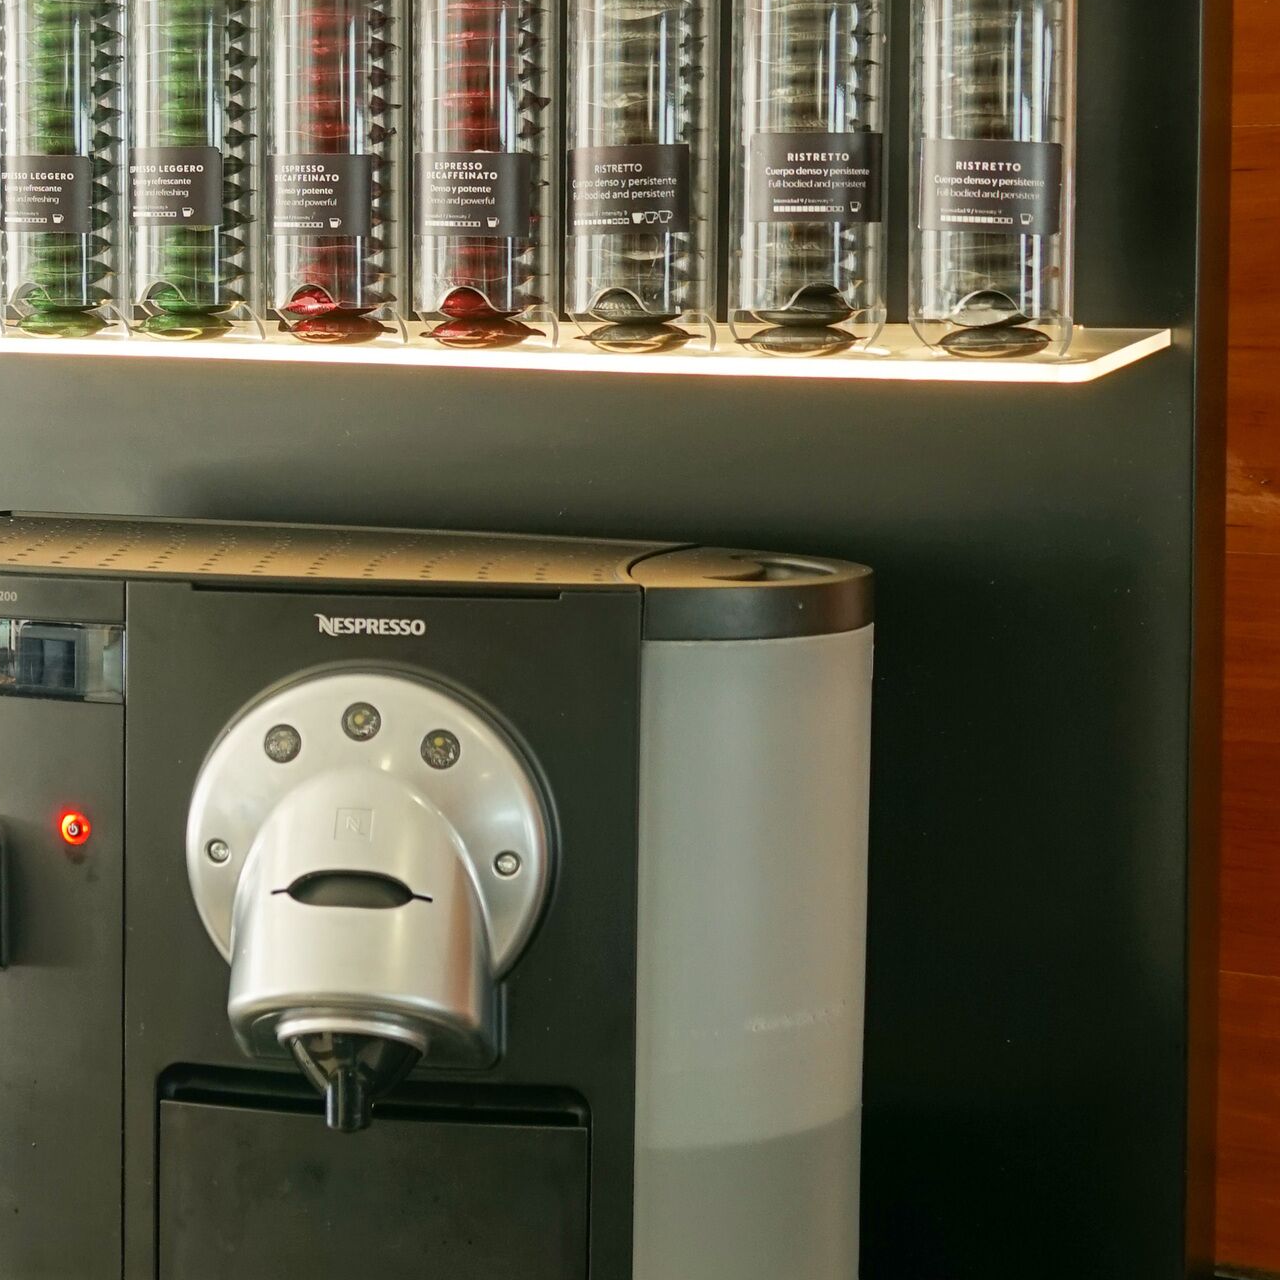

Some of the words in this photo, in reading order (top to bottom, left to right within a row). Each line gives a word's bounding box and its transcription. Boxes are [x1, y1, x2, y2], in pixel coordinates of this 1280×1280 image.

[787, 153, 849, 161] RISTRETTO
[159, 165, 204, 173] LEGGERO
[281, 165, 325, 173] ESPRESSO
[434, 162, 483, 170] ESPRESSO
[594, 163, 643, 174] RISTRETTO
[956, 161, 1021, 171] RISTRETTO
[426, 172, 498, 180] DECAFFEINATO
[765, 167, 794, 177] Cuerpo
[796, 167, 822, 175] denso
[830, 168, 870, 176] persistente
[151, 178, 192, 186] refrescante
[595, 178, 619, 188] denso
[621, 180, 627, 188] y
[628, 177, 677, 188] persistente
[814, 180, 830, 188] and
[832, 181, 866, 189] persistent
[934, 175, 962, 185] Cuerpo
[963, 176, 991, 185] denso
[992, 179, 998, 187] y
[999, 178, 1045, 187] persistente
[23, 184, 62, 192] refrescante
[301, 187, 334, 195] potente
[458, 186, 492, 194] potente
[155, 189, 189, 198] refreshing
[612, 189, 630, 199] and
[631, 189, 675, 199] persistent
[981, 190, 999, 198] and
[26, 195, 60, 205] refreshing
[304, 198, 337, 207] powerful
[446, 197, 460, 205] and
[460, 196, 496, 206] powerful
[314, 613, 426, 637] NESPRESSO
